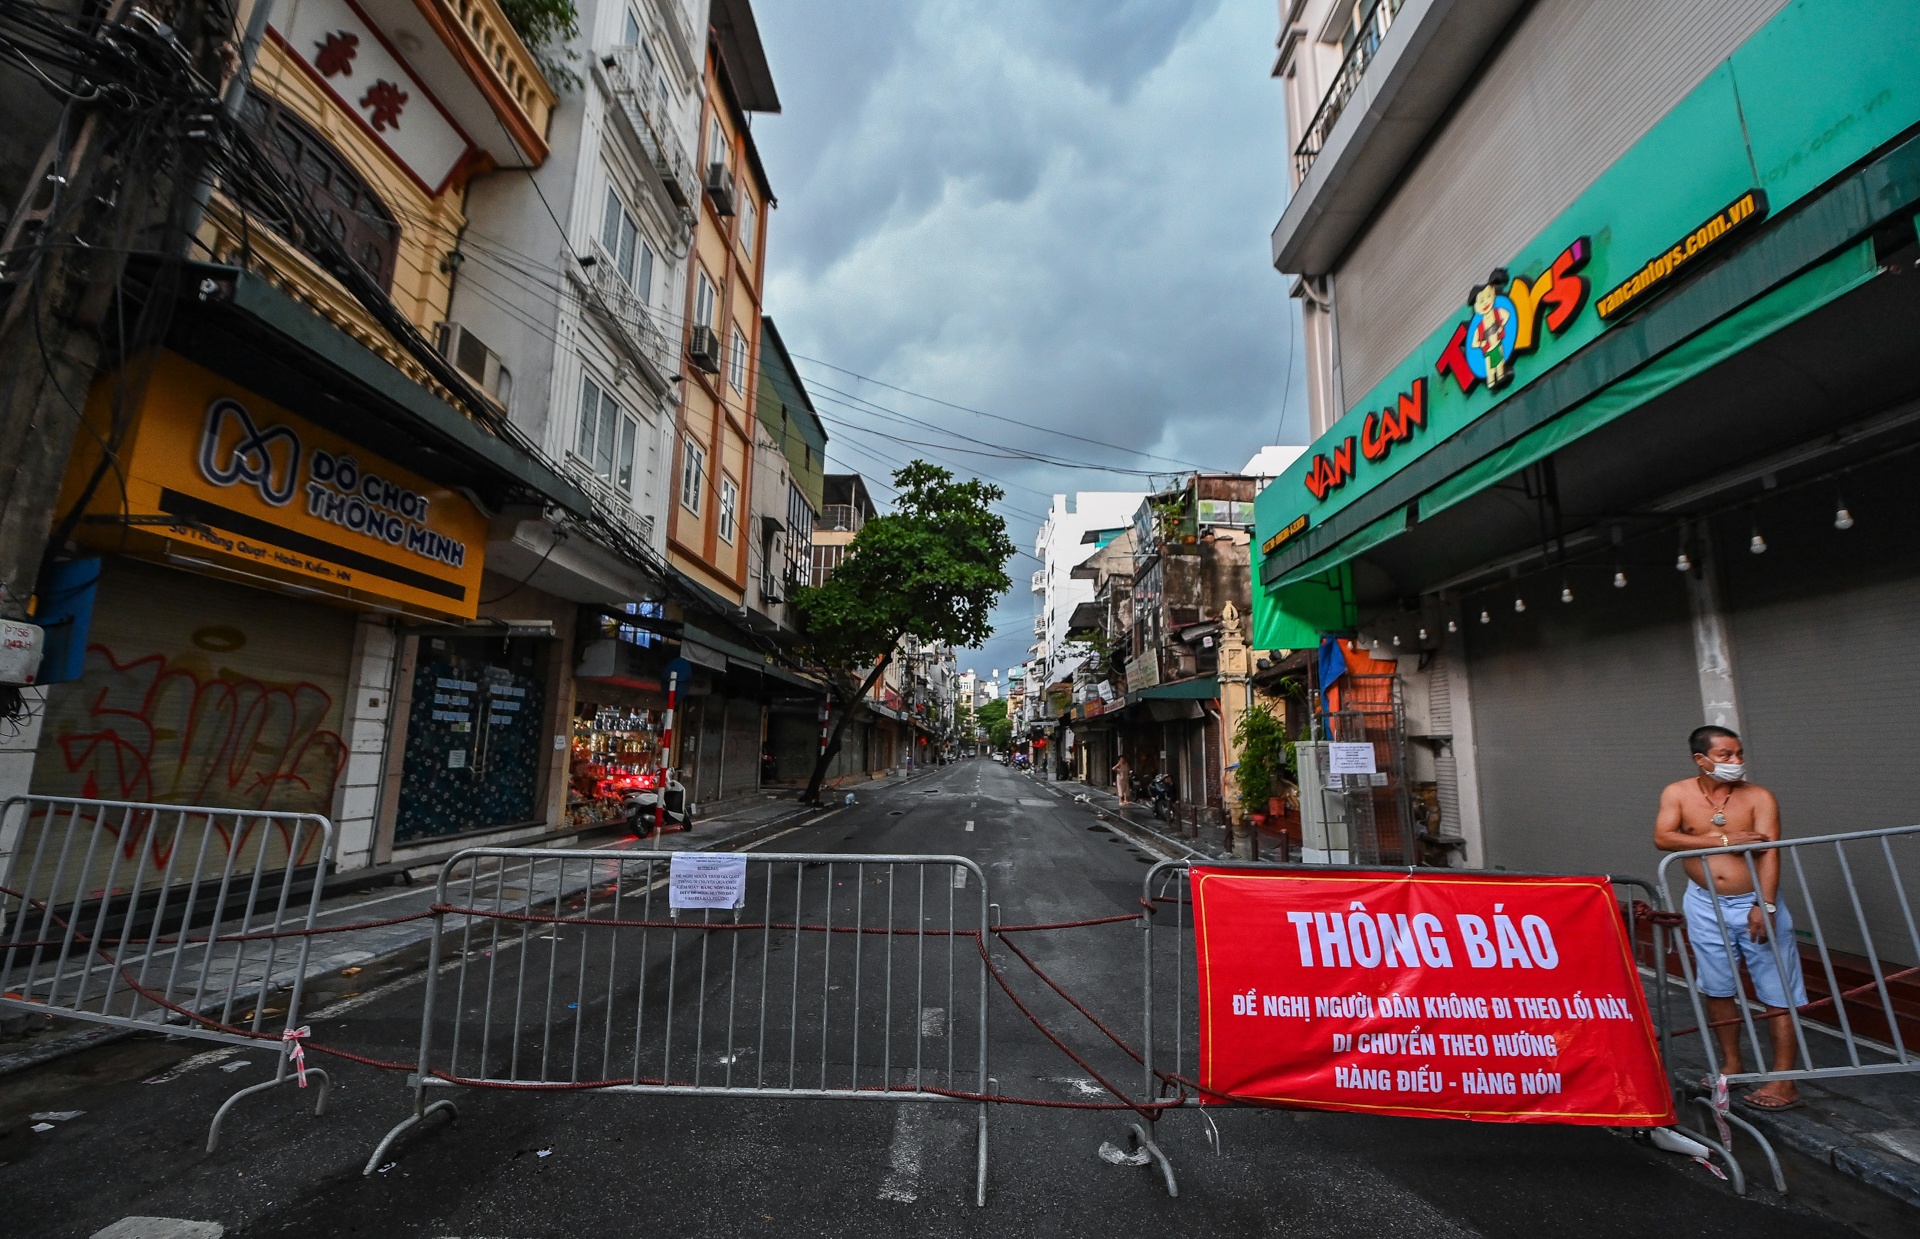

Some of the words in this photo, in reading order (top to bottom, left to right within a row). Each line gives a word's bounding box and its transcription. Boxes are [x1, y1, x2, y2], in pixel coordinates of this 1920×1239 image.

[1597, 193, 1755, 318] vancantoys.com.vn
[1304, 436, 1353, 500] VAN
[1361, 378, 1425, 460] CAN
[310, 448, 359, 493] ĐỒ
[306, 481, 405, 545] THÔNG
[405, 524, 465, 569] MINH
[237, 540, 266, 559] Quạt
[274, 551, 303, 567] Hoàn
[336, 569, 352, 582] HN
[1286, 901, 1454, 969] THÔNG
[1456, 903, 1559, 970] BÁO
[1232, 987, 1258, 1016] ĐỀ
[1262, 995, 1311, 1022] NGHỊ
[1314, 991, 1374, 1018] NGƯỜI
[1377, 992, 1421, 1018] DÂN
[1423, 992, 1489, 1019] KHÔNG
[1491, 997, 1513, 1019] ĐI
[1514, 997, 1562, 1020] THEO
[1563, 990, 1595, 1020] LỐI
[1595, 993, 1634, 1022] NÀY,
[1332, 1033, 1353, 1053] DI
[1357, 1025, 1436, 1056] CHUYỂN
[1439, 1033, 1489, 1057] THEO
[1491, 1030, 1558, 1057] HƯỚNG
[1334, 1063, 1391, 1091] HÀNG
[1396, 1064, 1443, 1093] ĐIẾU
[1461, 1067, 1517, 1095] HÀNG
[1520, 1068, 1562, 1094] NÓN
